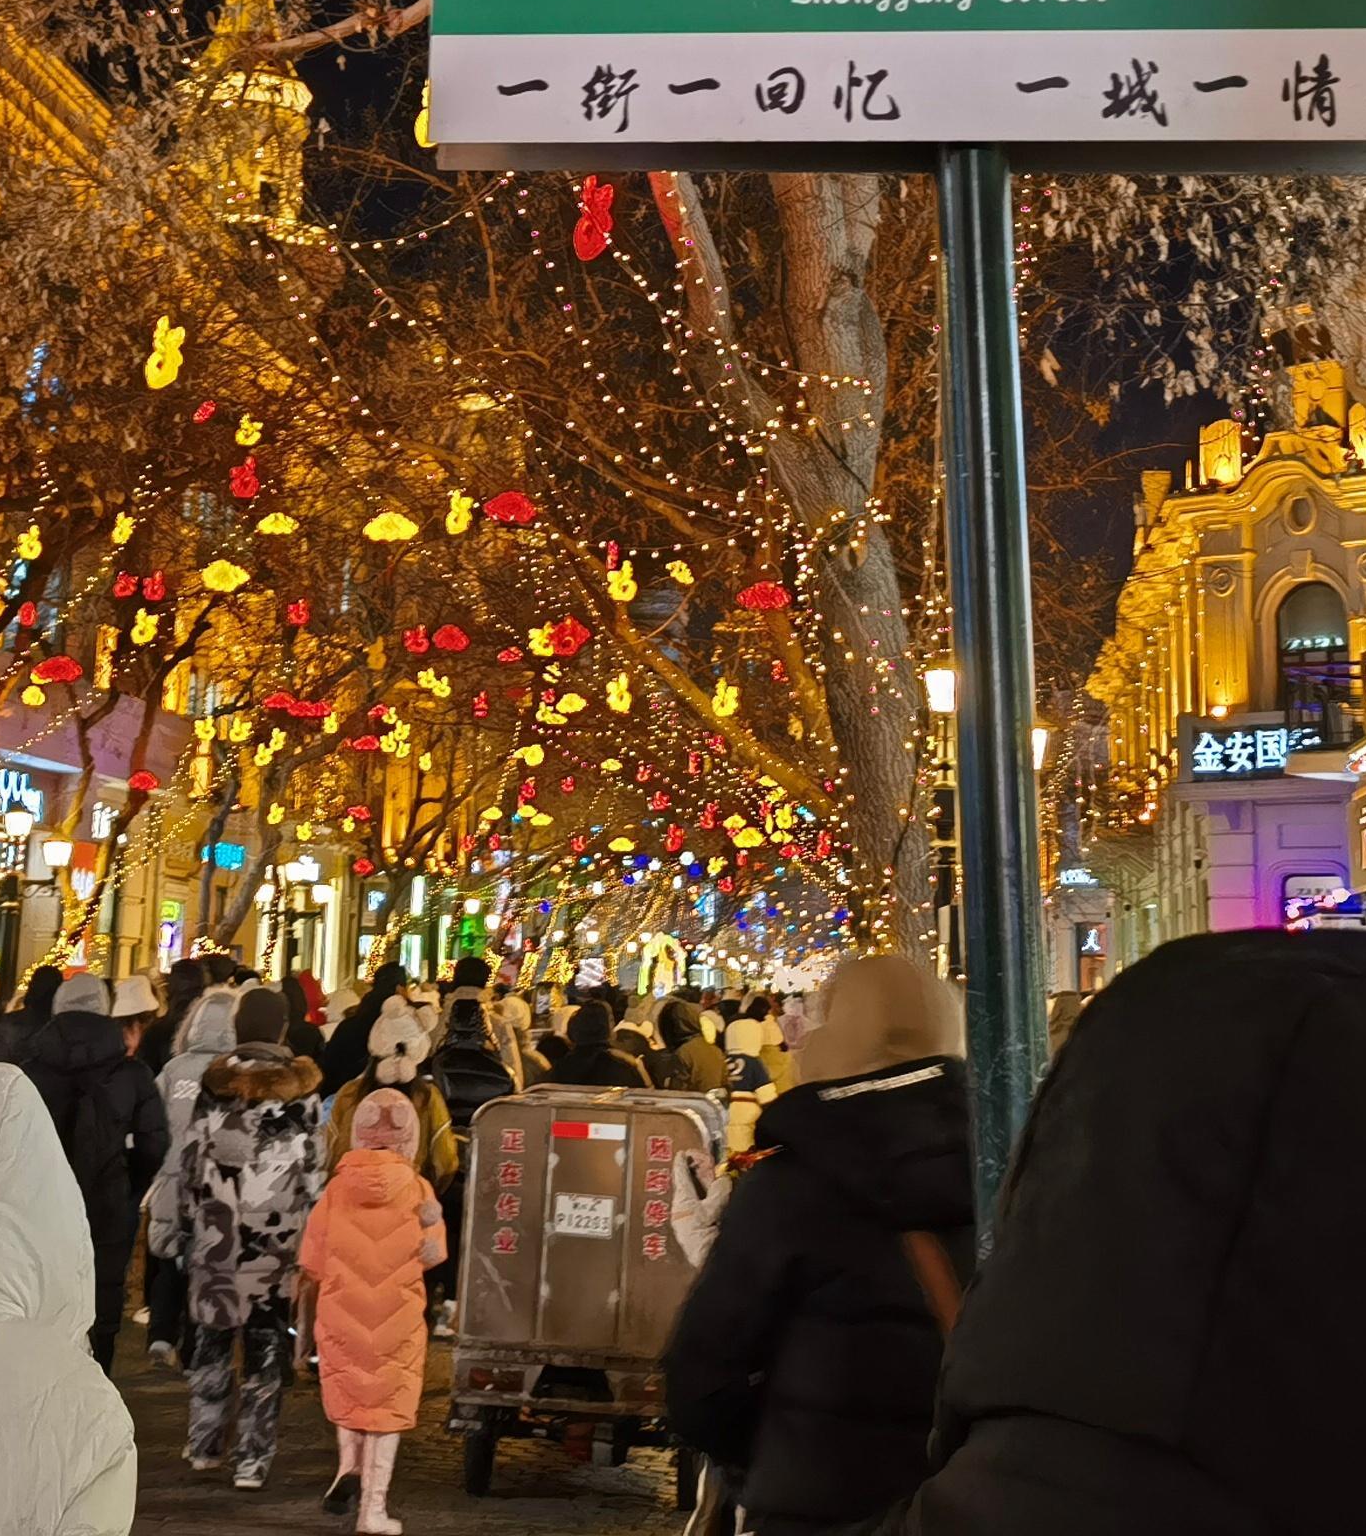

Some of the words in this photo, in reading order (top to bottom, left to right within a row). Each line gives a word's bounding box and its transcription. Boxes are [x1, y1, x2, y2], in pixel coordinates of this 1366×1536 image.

[497, 60, 901, 133] 一街一回忆
[491, 1128, 525, 1254] 正在作业
